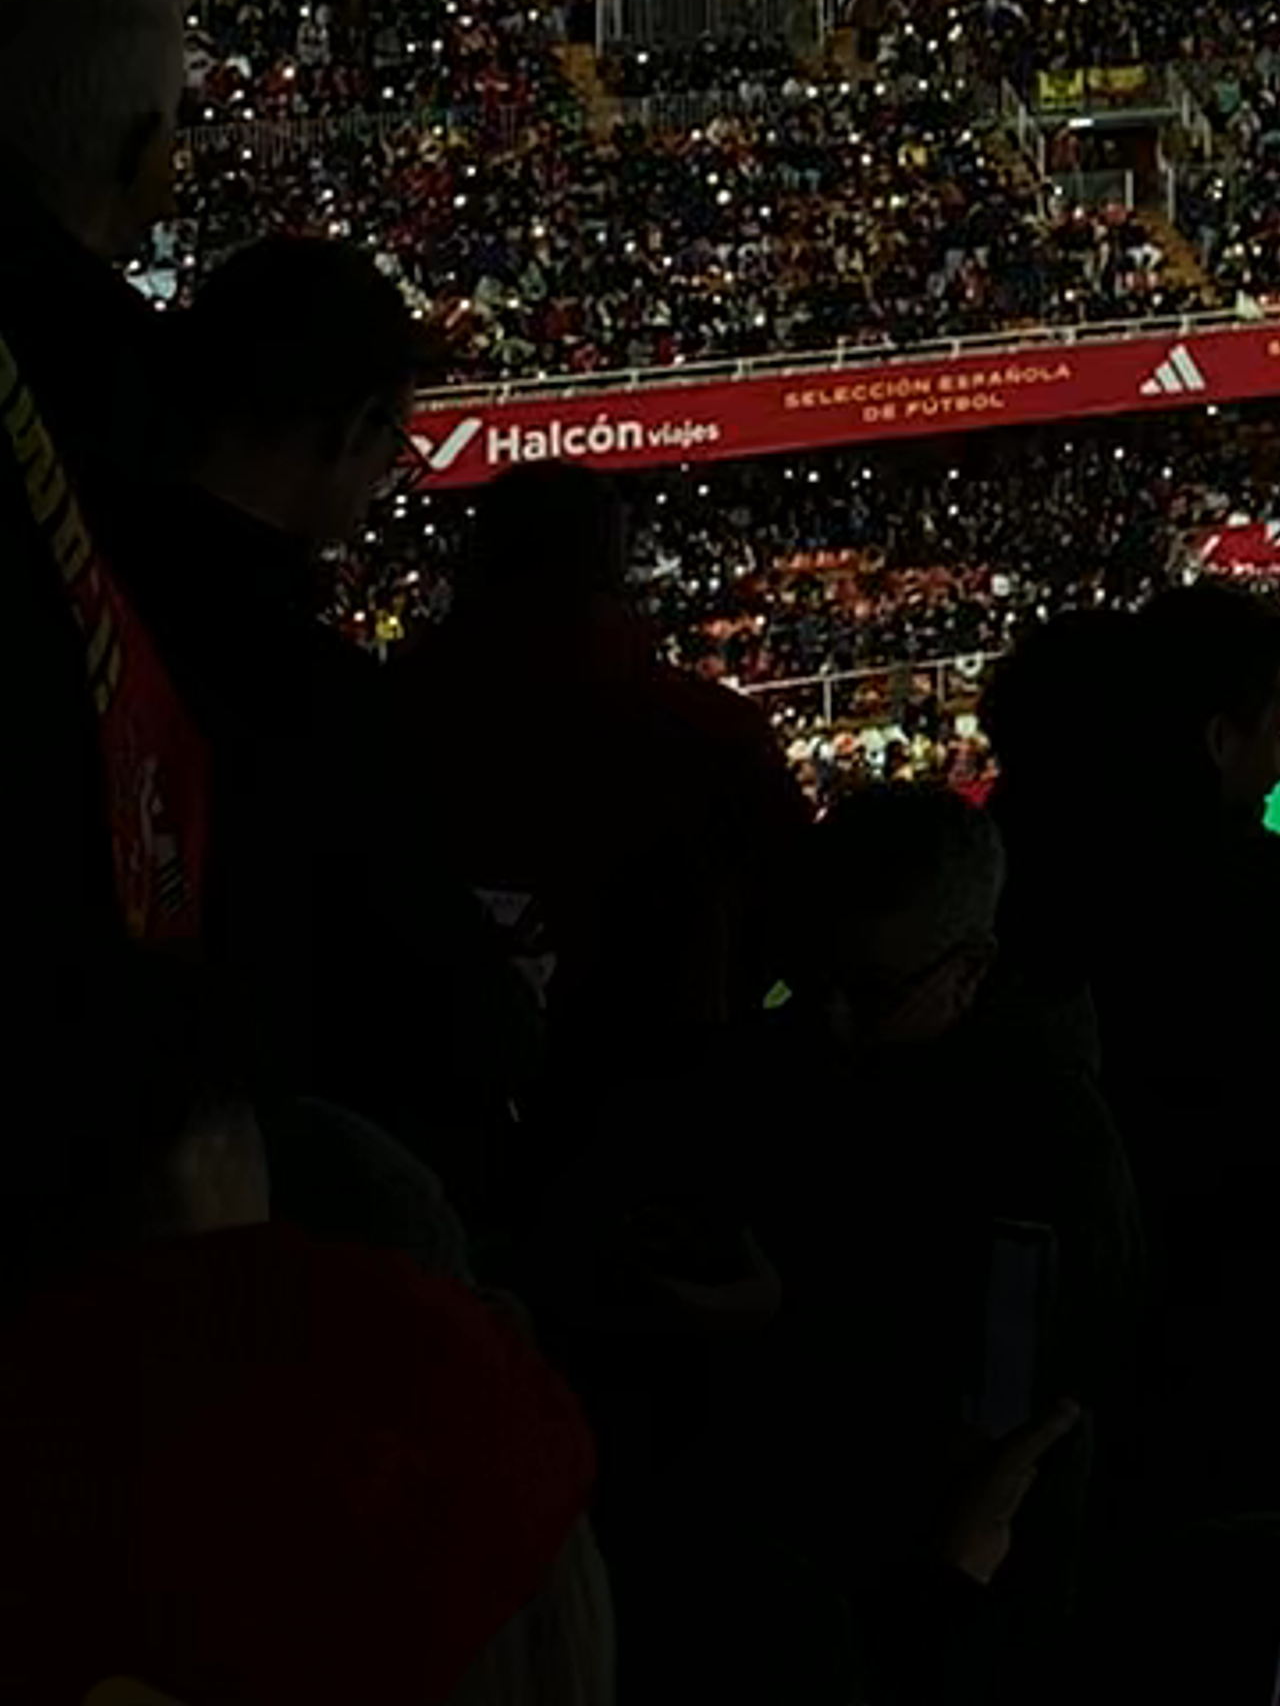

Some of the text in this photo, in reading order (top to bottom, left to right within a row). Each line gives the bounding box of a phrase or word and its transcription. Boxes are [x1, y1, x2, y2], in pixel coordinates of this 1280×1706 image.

[783, 362, 1071, 409] SELECCIÓN ESPAÑOLA
[861, 392, 1005, 423] DE FÚTBOL
[486, 413, 644, 465] Halcón
